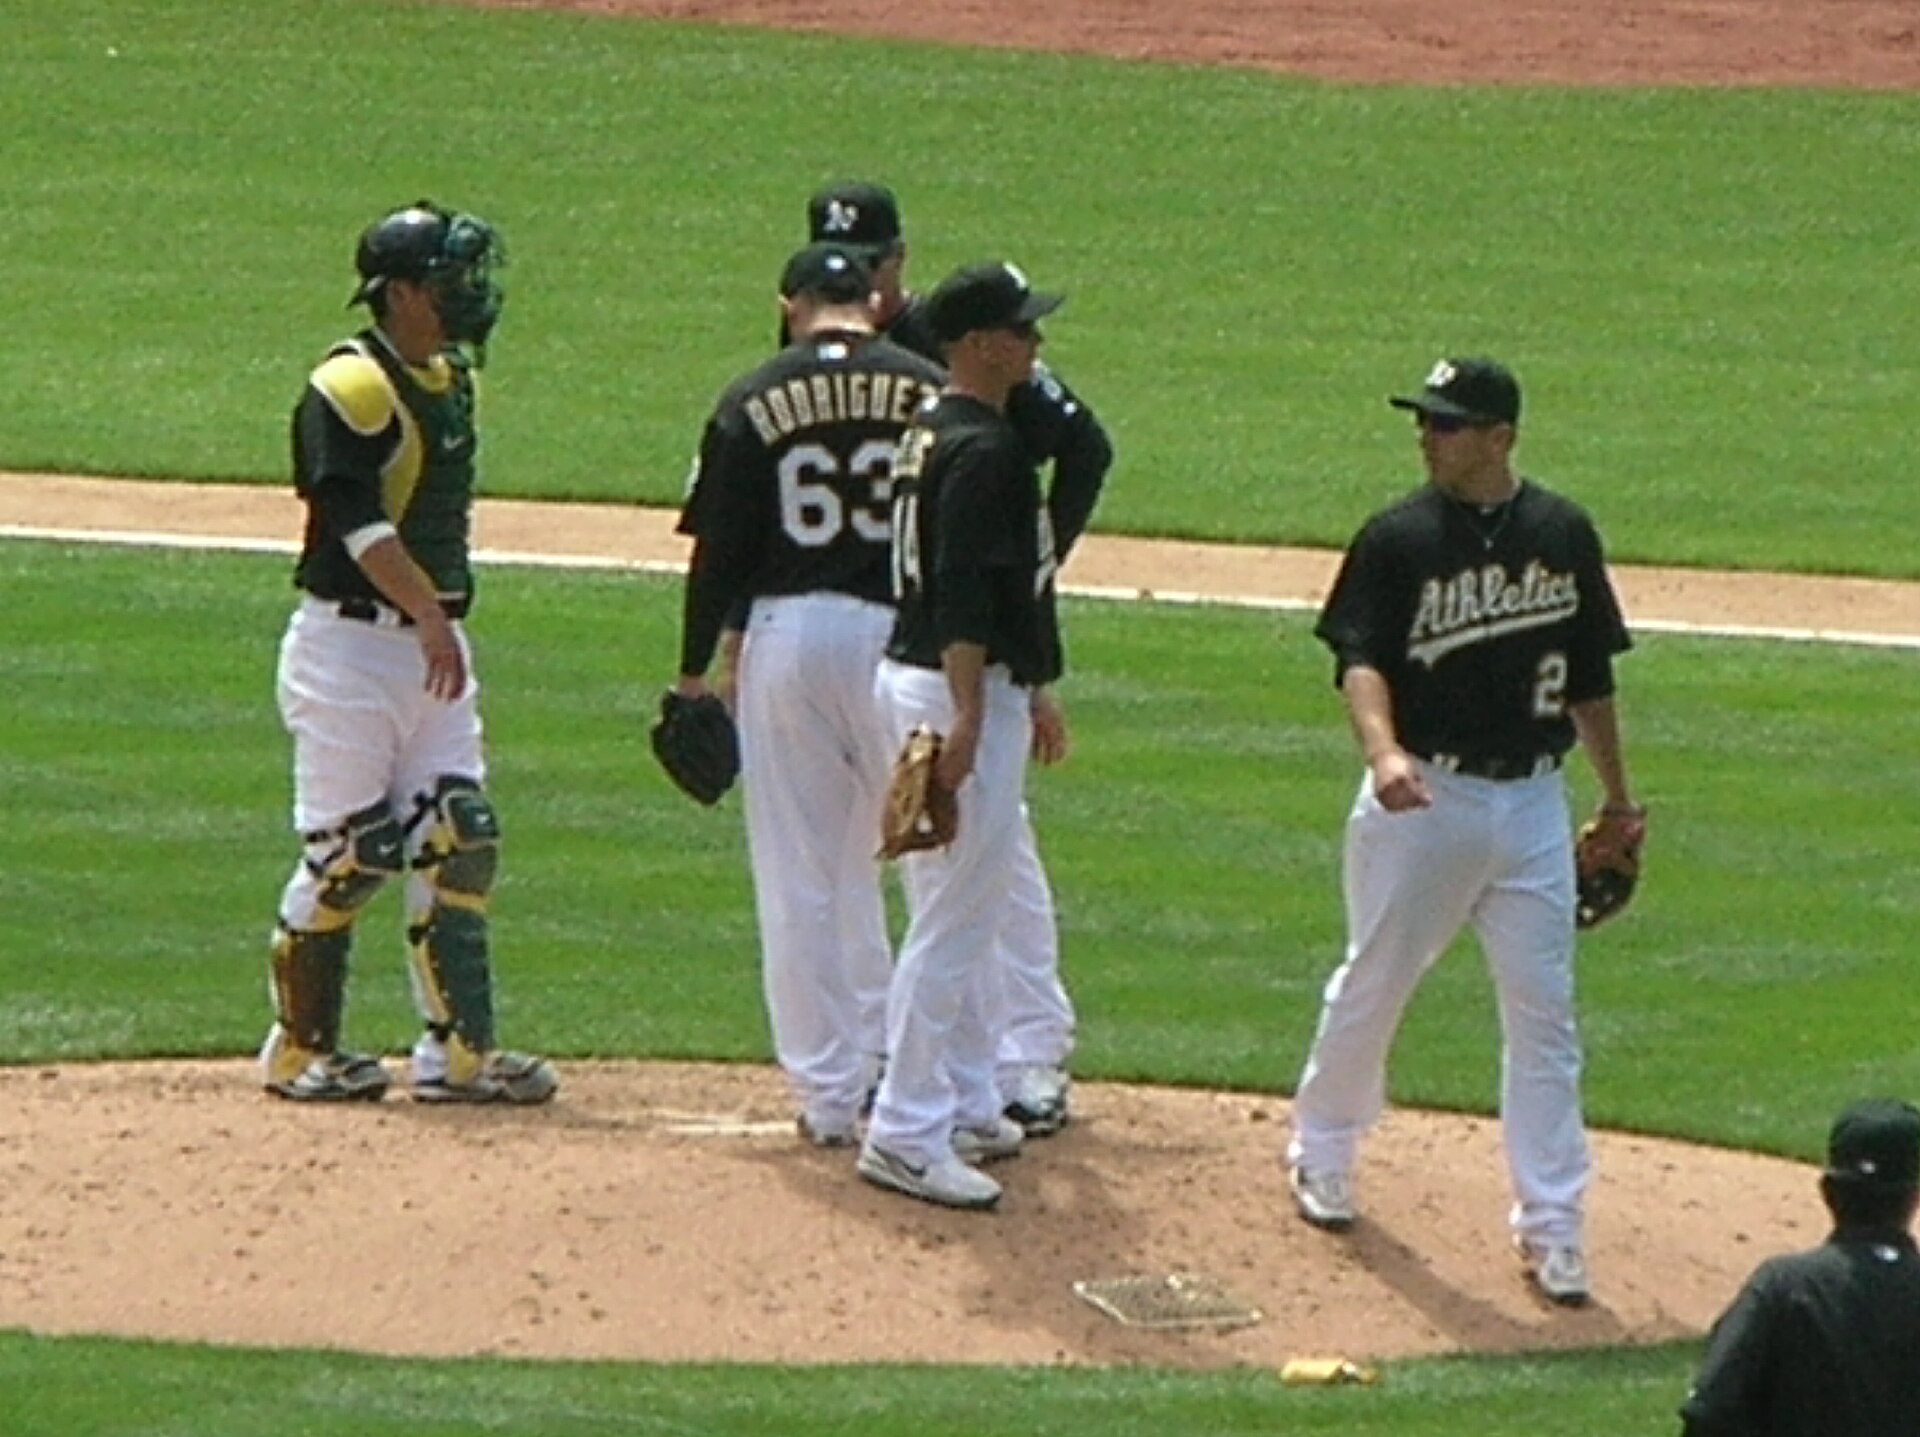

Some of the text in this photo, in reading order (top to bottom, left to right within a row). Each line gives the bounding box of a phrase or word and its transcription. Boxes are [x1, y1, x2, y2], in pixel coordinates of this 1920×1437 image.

[778, 442, 898, 547] 63
[1408, 556, 1581, 640] Athletics
[1533, 652, 1569, 718] 2
